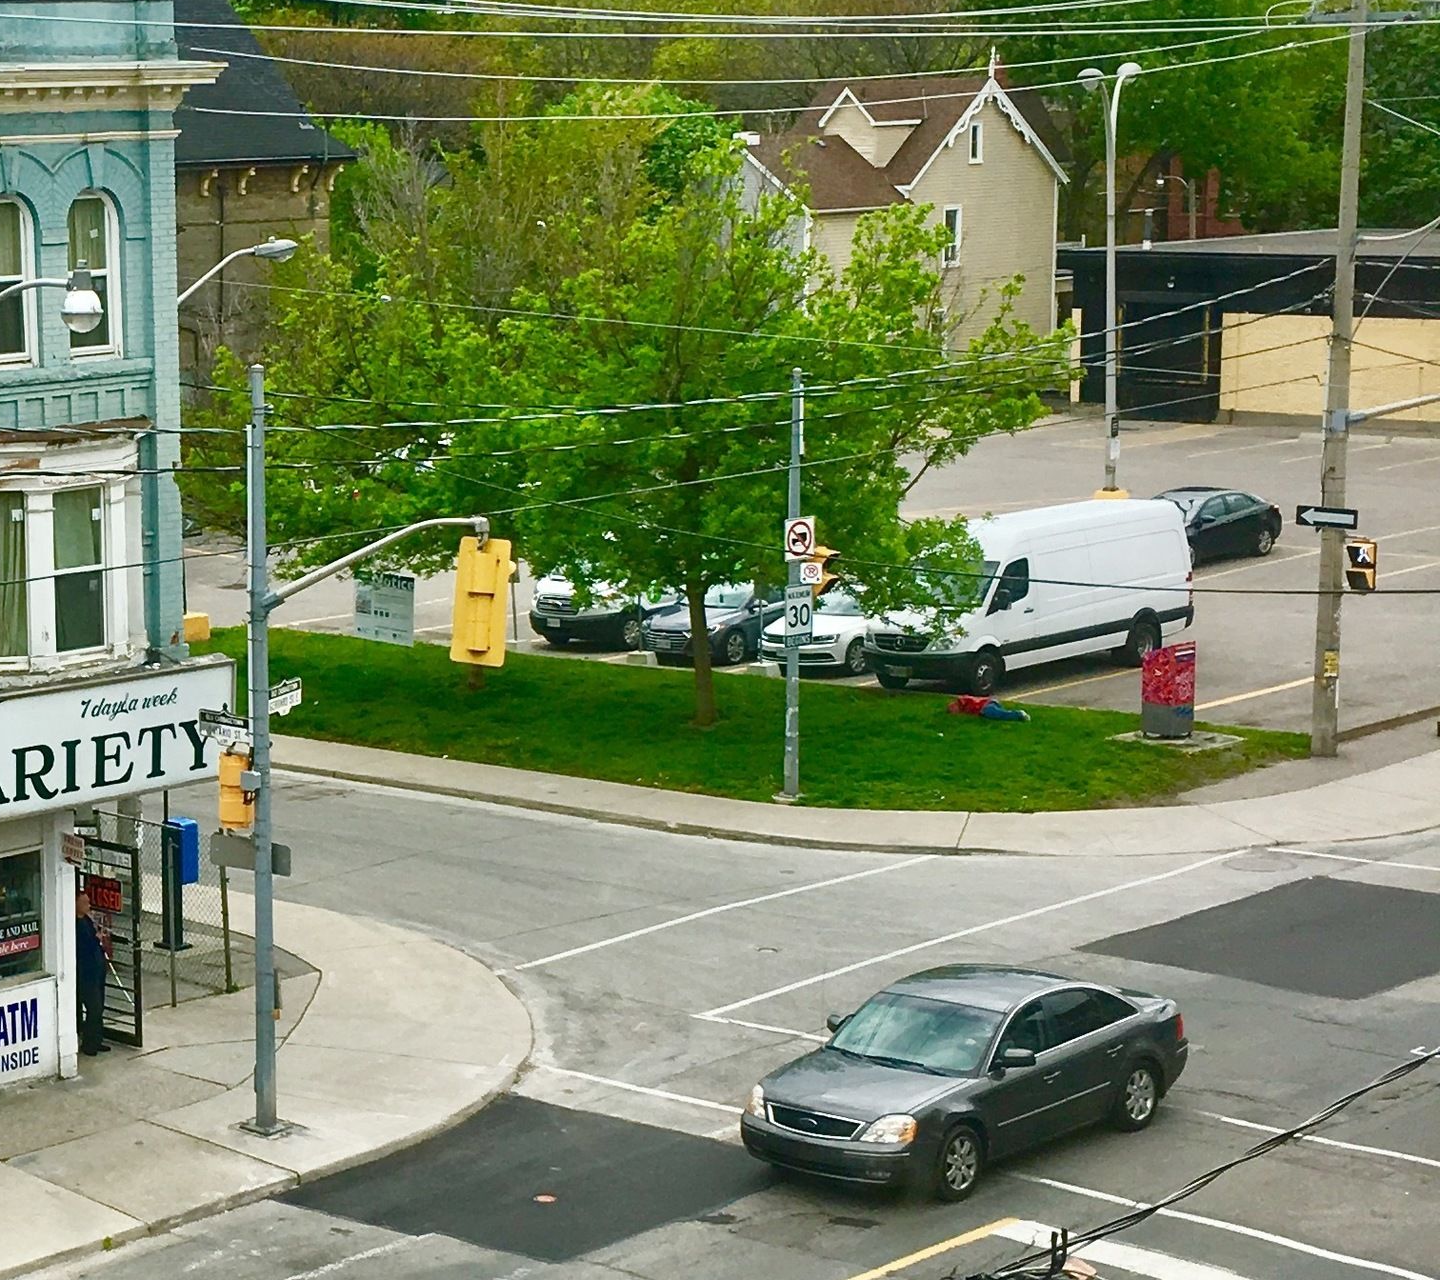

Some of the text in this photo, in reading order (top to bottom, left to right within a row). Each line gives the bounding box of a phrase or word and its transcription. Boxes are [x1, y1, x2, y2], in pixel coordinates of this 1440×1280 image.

[372, 573, 414, 591] Notice
[788, 603, 810, 628] 30
[80, 699, 91, 718] 7
[128, 698, 138, 711] a
[142, 686, 178, 709] week
[6, 926, 21, 938] AND
[20, 922, 39, 935] MAIL
